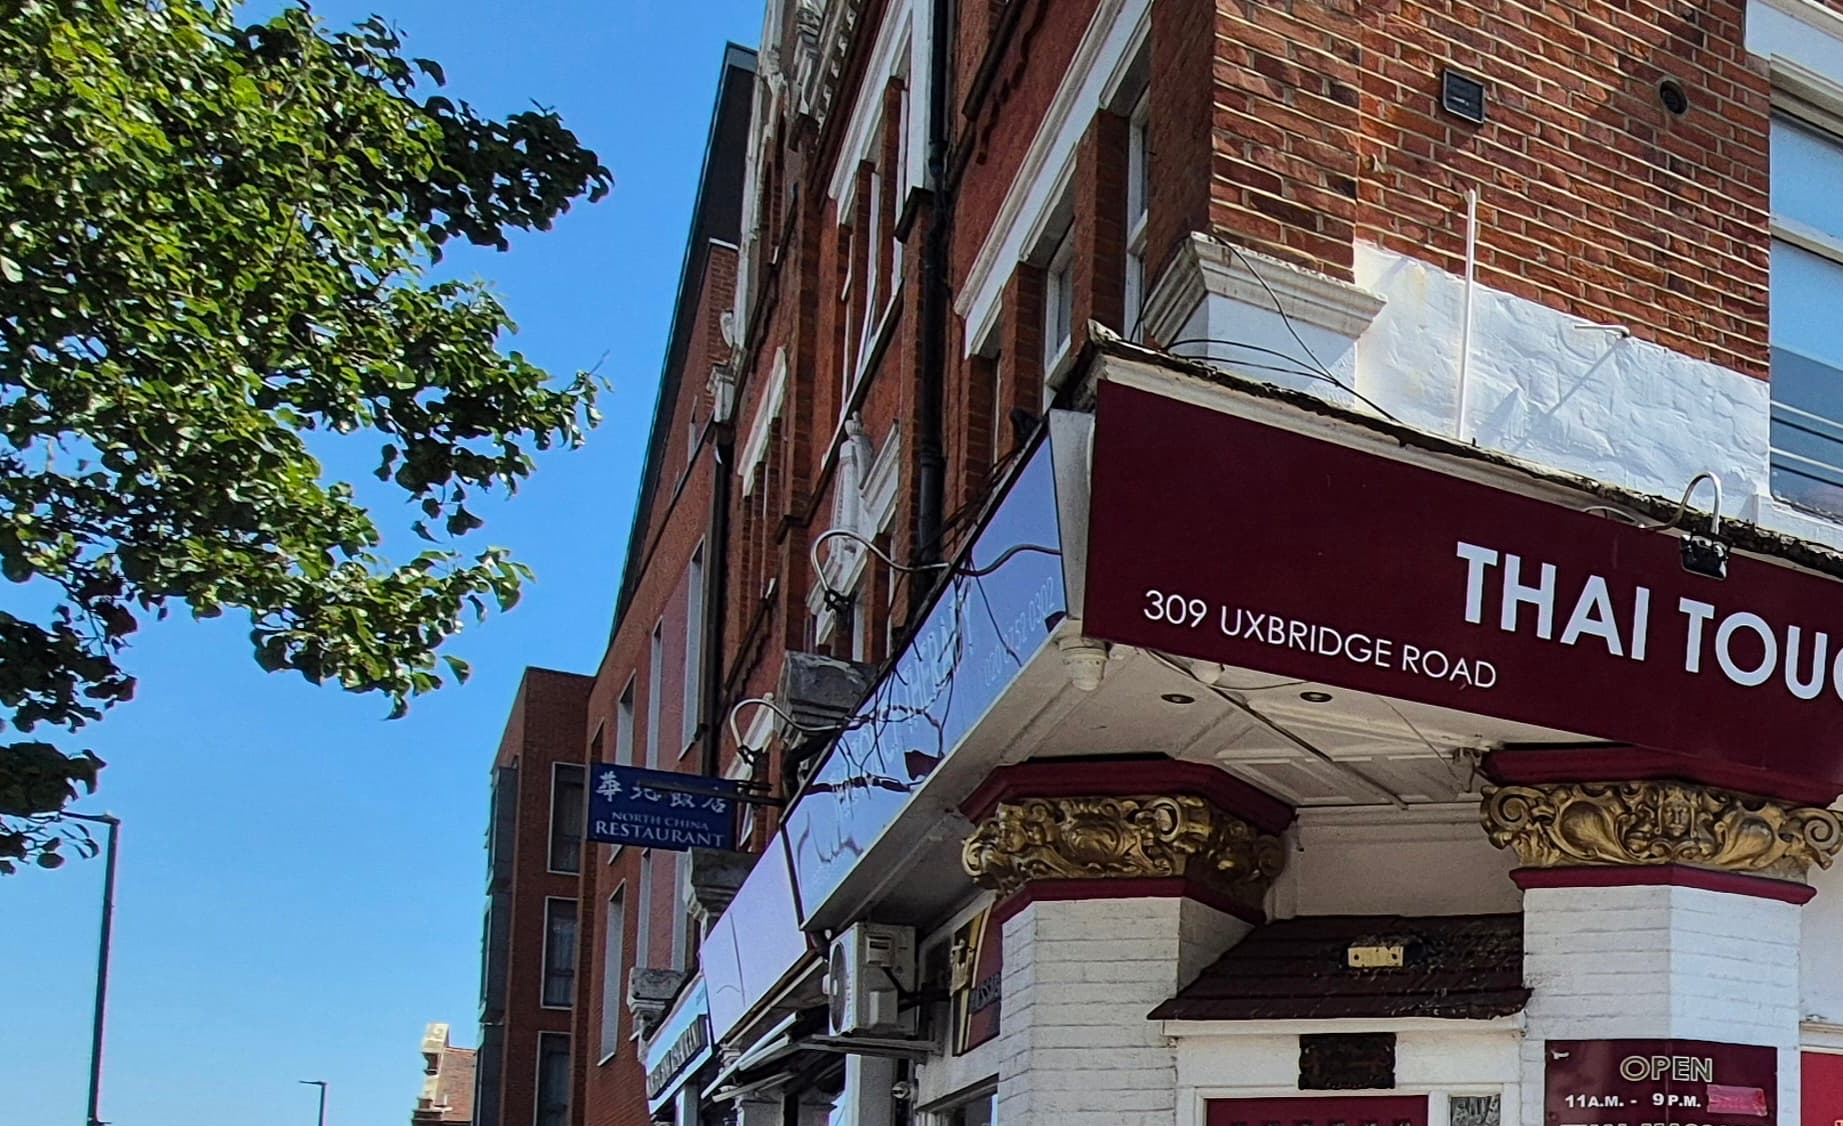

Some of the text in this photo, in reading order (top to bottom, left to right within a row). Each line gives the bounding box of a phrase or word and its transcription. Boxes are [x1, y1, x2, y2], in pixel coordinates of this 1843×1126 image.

[1456, 541, 1650, 660] THAI
[1143, 590, 1497, 688] 309 UXBRIDGE ROAD
[595, 820, 725, 847] RESTAURANT
[611, 811, 709, 832] NORTH CHINA
[1620, 1055, 1713, 1082] OPEN
